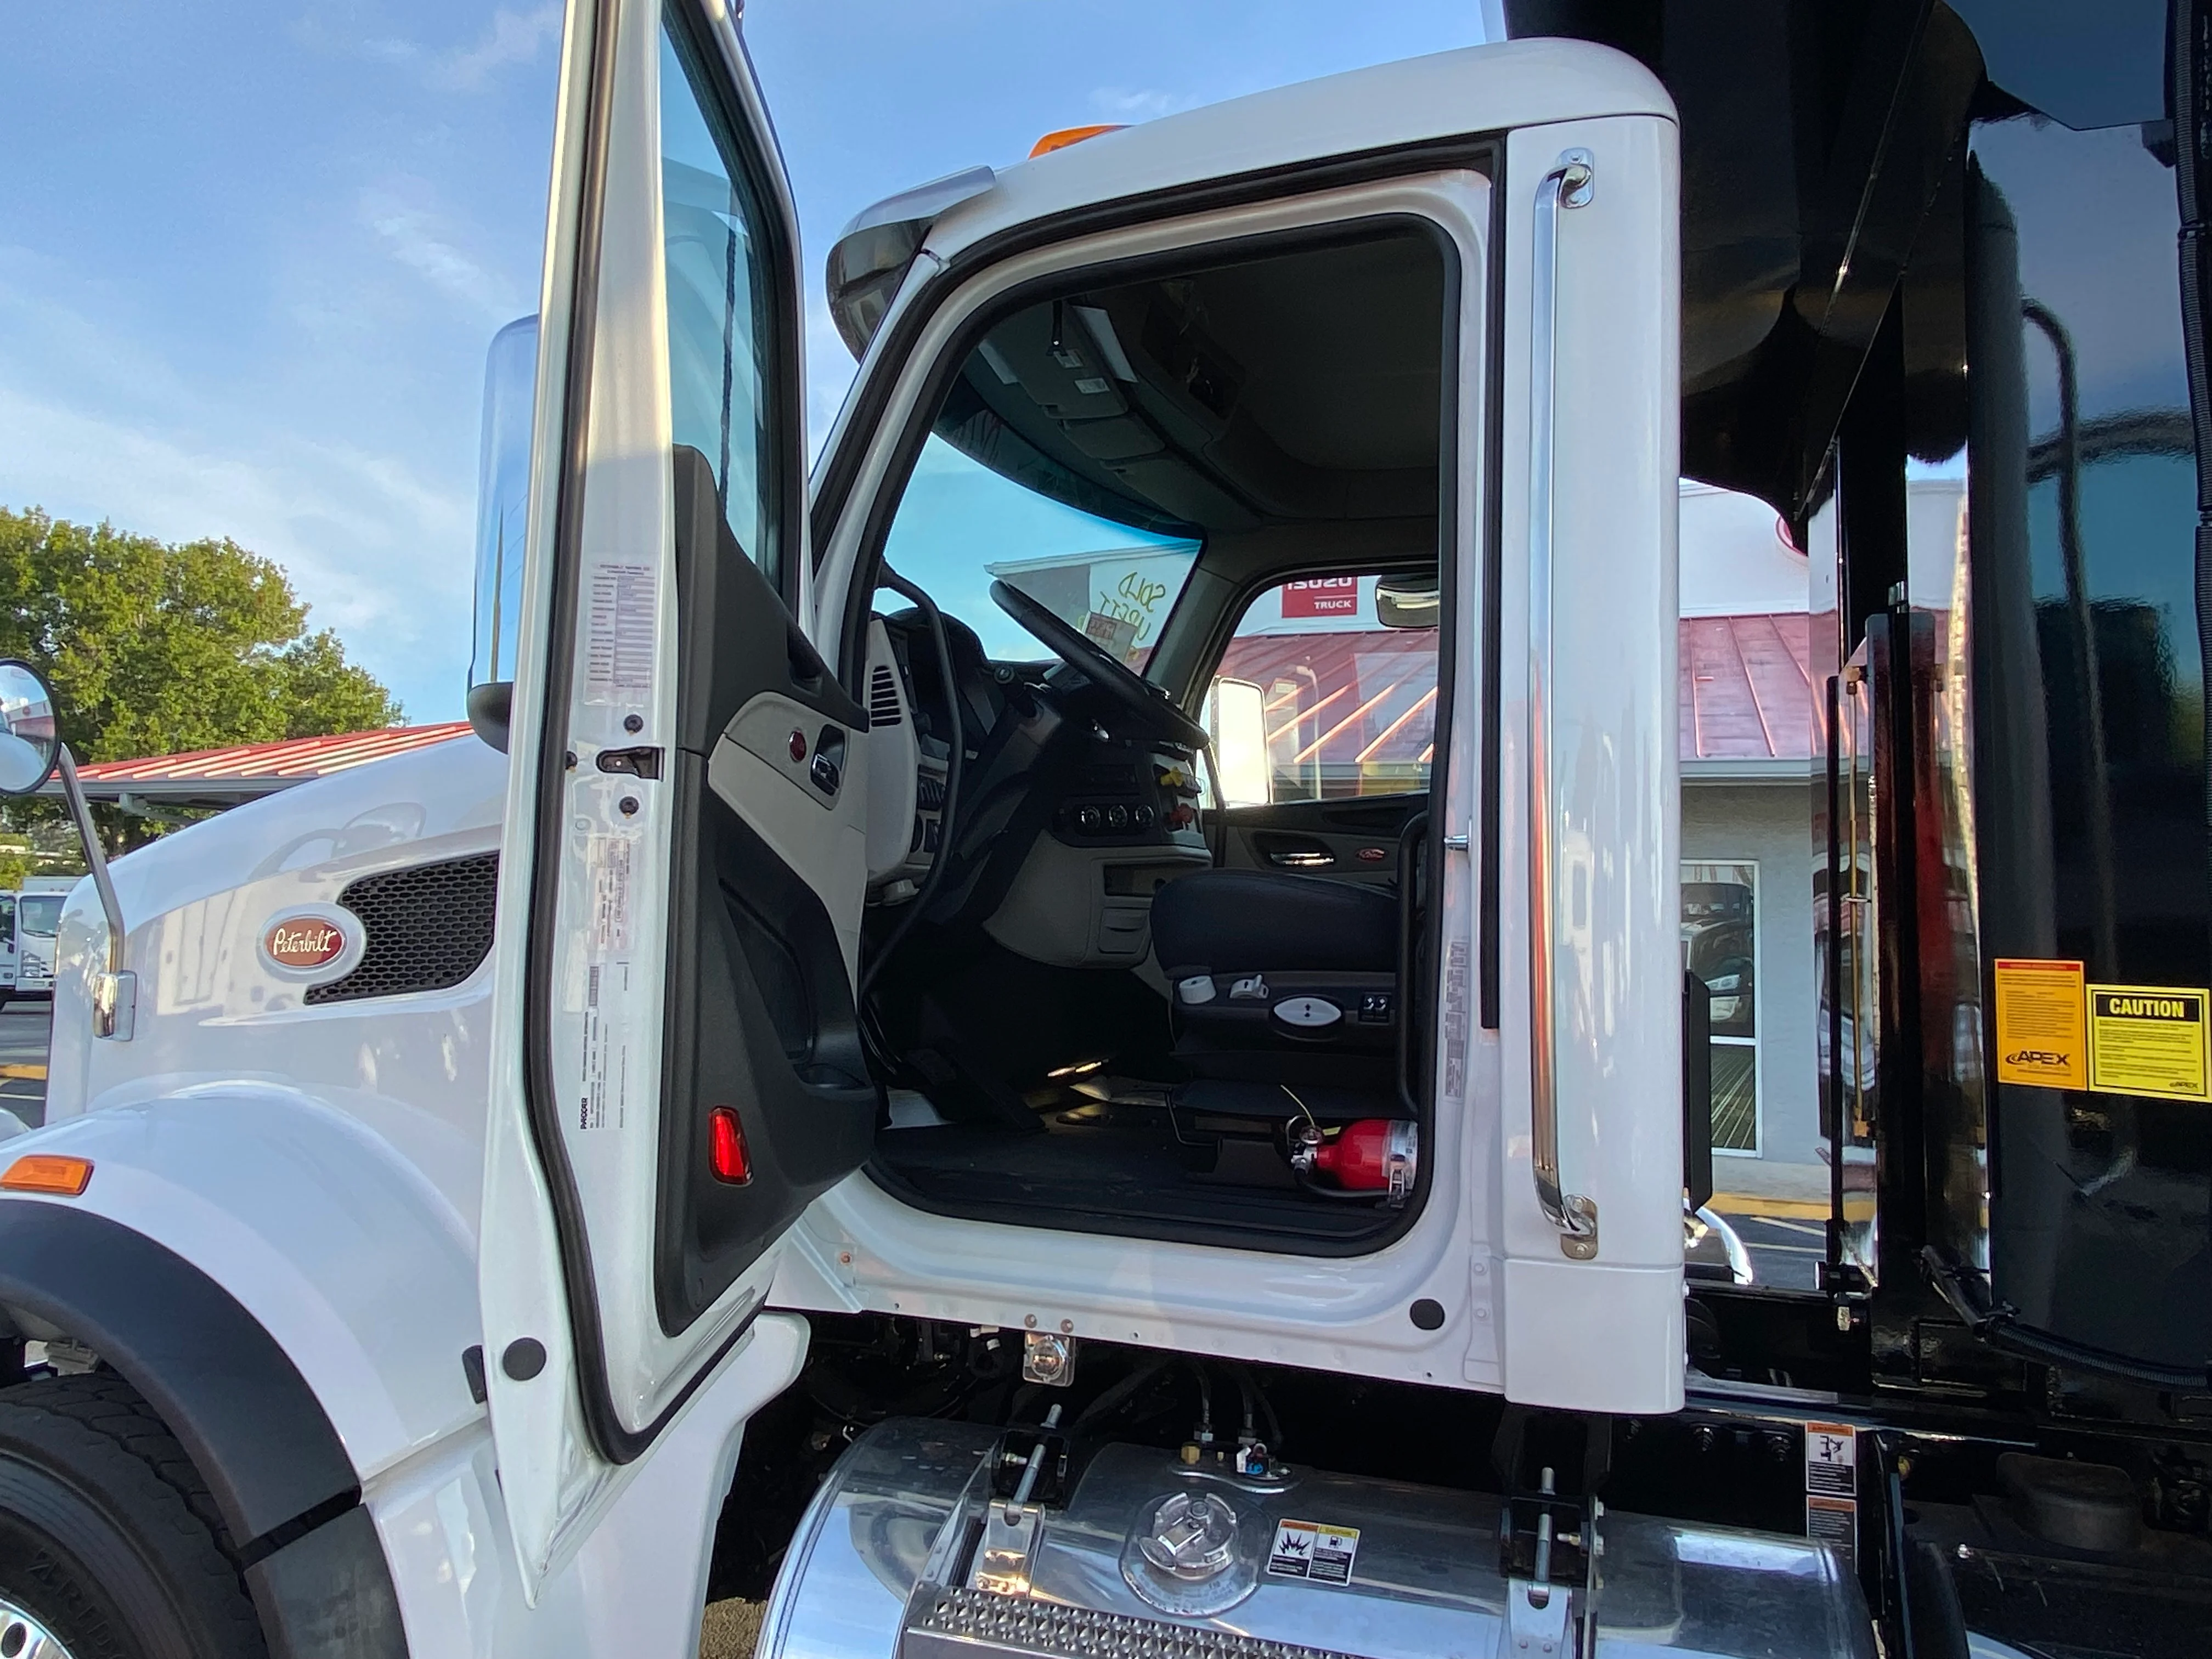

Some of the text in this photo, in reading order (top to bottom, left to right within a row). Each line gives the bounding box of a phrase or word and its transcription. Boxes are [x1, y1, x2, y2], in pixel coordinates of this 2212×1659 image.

[1314, 600, 1352, 610] TRUCK
[273, 928, 337, 956] Peterbilt
[2109, 997, 2185, 1018] CAUTION
[2017, 1050, 2071, 1067] APEX
